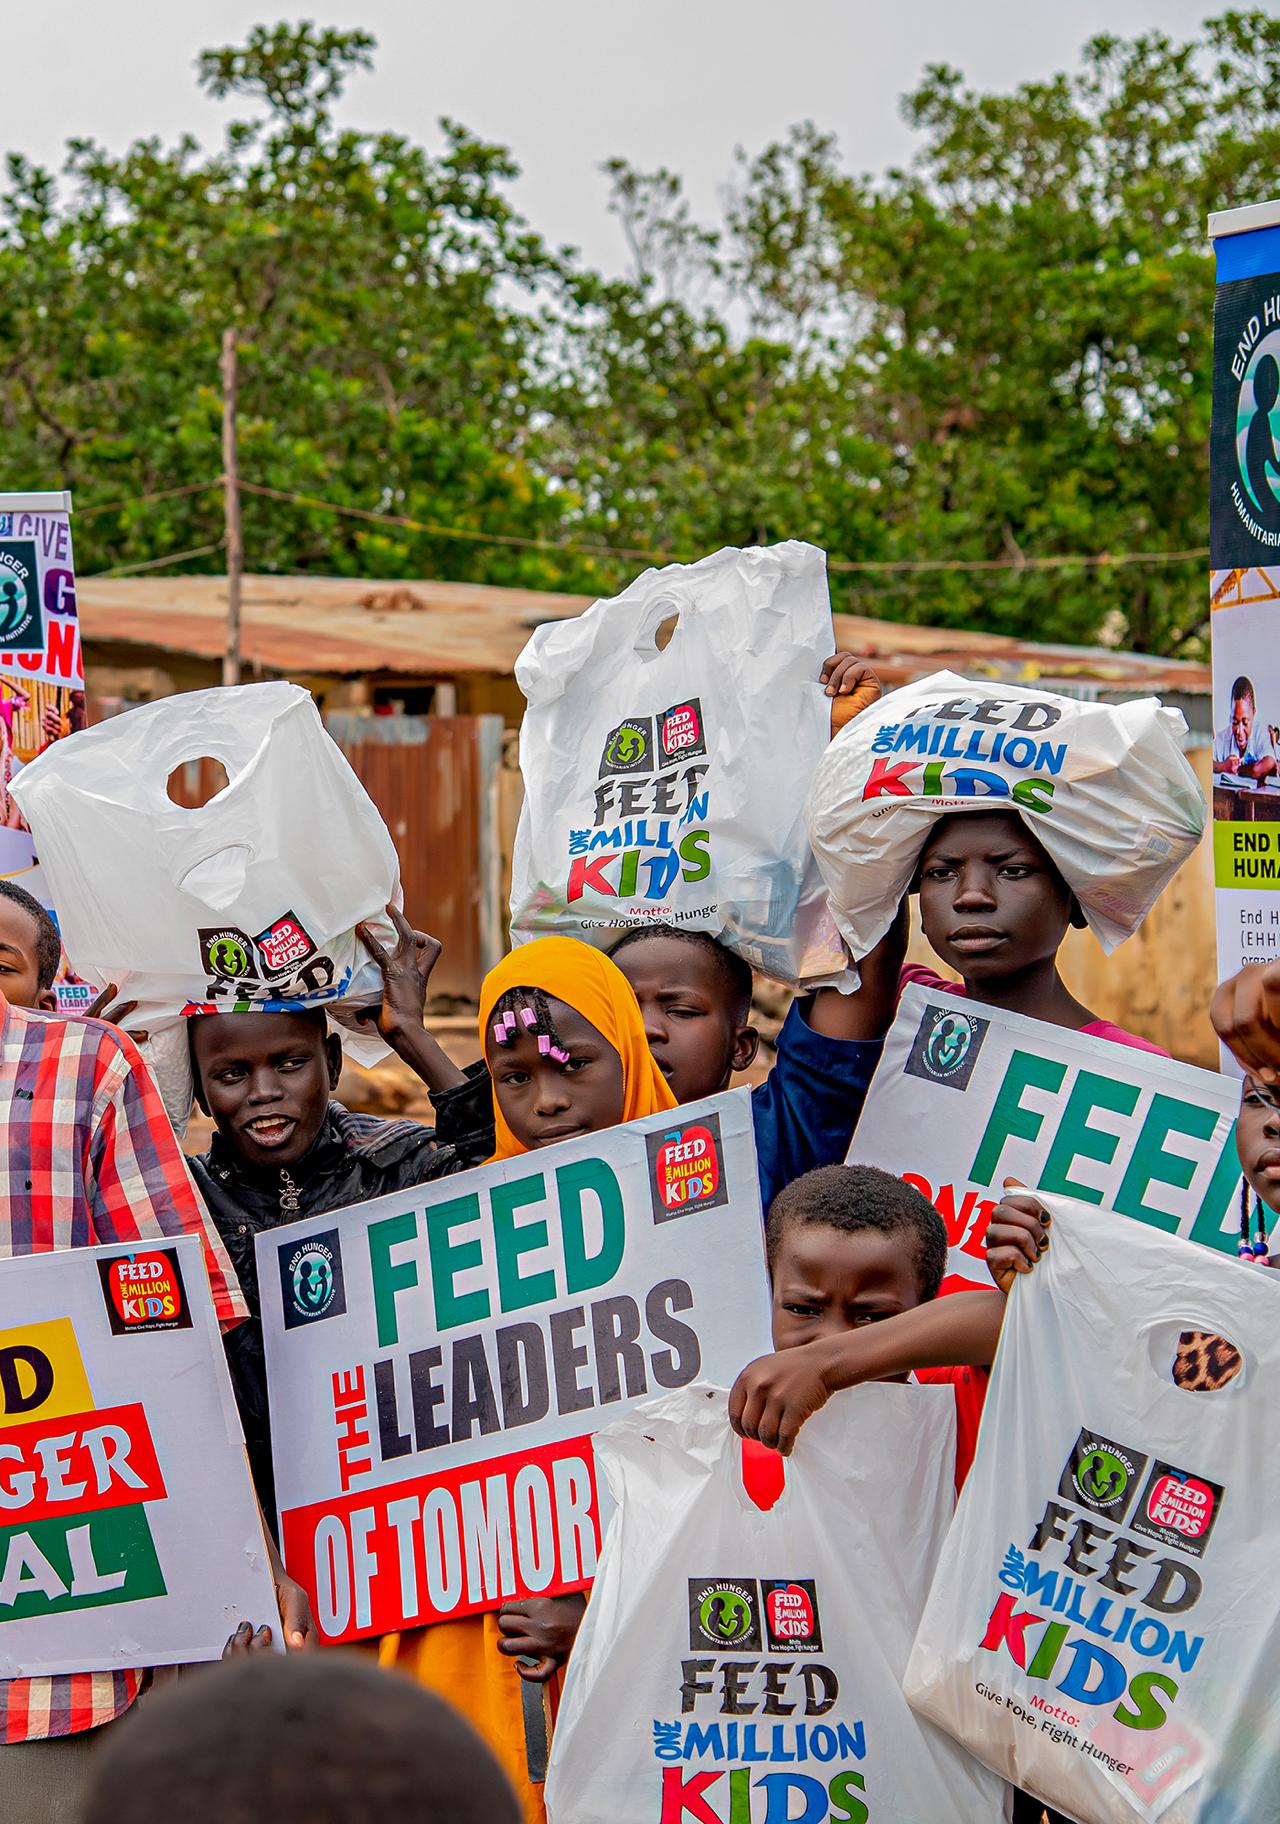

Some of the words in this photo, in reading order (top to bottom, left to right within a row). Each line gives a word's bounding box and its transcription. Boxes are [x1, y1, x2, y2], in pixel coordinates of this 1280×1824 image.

[1231, 315, 1261, 382] END
[667, 711, 690, 729] FEED
[667, 731, 695, 751] KIDS
[871, 724, 899, 754] ONE
[893, 724, 1068, 775] MILLION
[862, 757, 1055, 814] KIDS
[569, 829, 591, 855] ONE
[1233, 833, 1270, 852] END
[567, 830, 711, 904] KIDS
[675, 904, 718, 920] Hunge
[1240, 910, 1262, 924] End
[219, 931, 248, 949] HUNGER
[263, 924, 292, 949] FEED
[271, 941, 308, 966] KIDS
[58, 987, 88, 999] FEED
[665, 1138, 706, 1165] FEED
[665, 1165, 673, 1183] ONE
[673, 1157, 711, 1180] MILLION
[666, 1173, 713, 1205] KIDS
[289, 1251, 302, 1272] END
[301, 1242, 333, 1261] HUNGER
[368, 1157, 626, 1348] FEED
[118, 1262, 163, 1281] FEED
[120, 1282, 129, 1298] ONE
[129, 1280, 170, 1296] MILLION
[122, 1296, 175, 1319] KIDS
[331, 1365, 372, 1491] THE
[374, 1278, 701, 1461] LEADERS
[1082, 1443, 1097, 1456] END
[1100, 1444, 1135, 1477] HUNGER
[1165, 1480, 1206, 1505] FEED
[1151, 1505, 1201, 1535] KIDS
[1166, 1498, 1205, 1519] MILLION
[1134, 1523, 1147, 1533] Give
[1028, 1501, 1203, 1614] FEED
[314, 1508, 377, 1636] OF
[697, 1586, 714, 1603] END
[716, 1583, 753, 1604] HUNGER
[775, 1593, 802, 1607] FEED
[998, 1542, 1026, 1591] ONE
[1022, 1560, 1206, 1673] MILLION
[775, 1620, 809, 1636] KIDS
[978, 1591, 1179, 1730] KIDS
[679, 1659, 839, 1716] FEED
[1030, 1695, 1080, 1728] Motto:
[653, 1719, 682, 1761] ONE
[682, 1721, 867, 1762] MILLION
[975, 1682, 1003, 1705] Give
[1041, 1721, 1078, 1749] Fight
[1080, 1740, 1135, 1776] Hunger
[660, 1766, 869, 1824] KIDS
